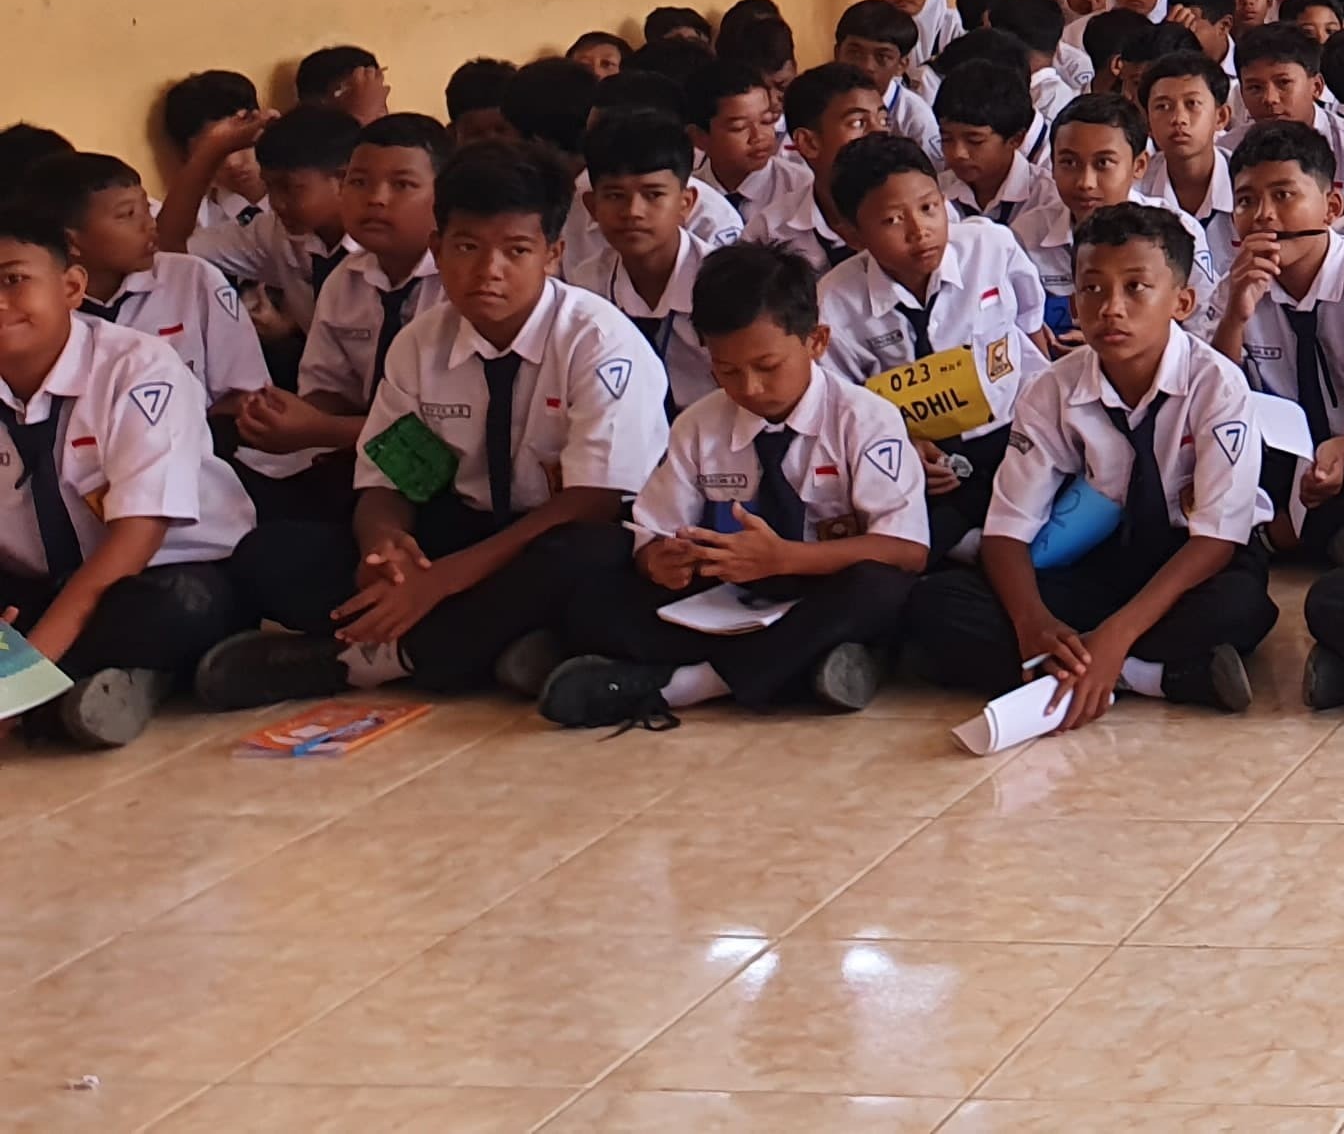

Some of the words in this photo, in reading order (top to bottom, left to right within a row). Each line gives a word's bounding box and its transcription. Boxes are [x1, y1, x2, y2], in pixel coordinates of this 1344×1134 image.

[609, 366, 624, 389] 7
[889, 362, 932, 393] 023
[143, 390, 161, 414] 7
[900, 388, 969, 423] ADHIL
[1225, 428, 1241, 453] 7
[878, 446, 893, 470] 7
